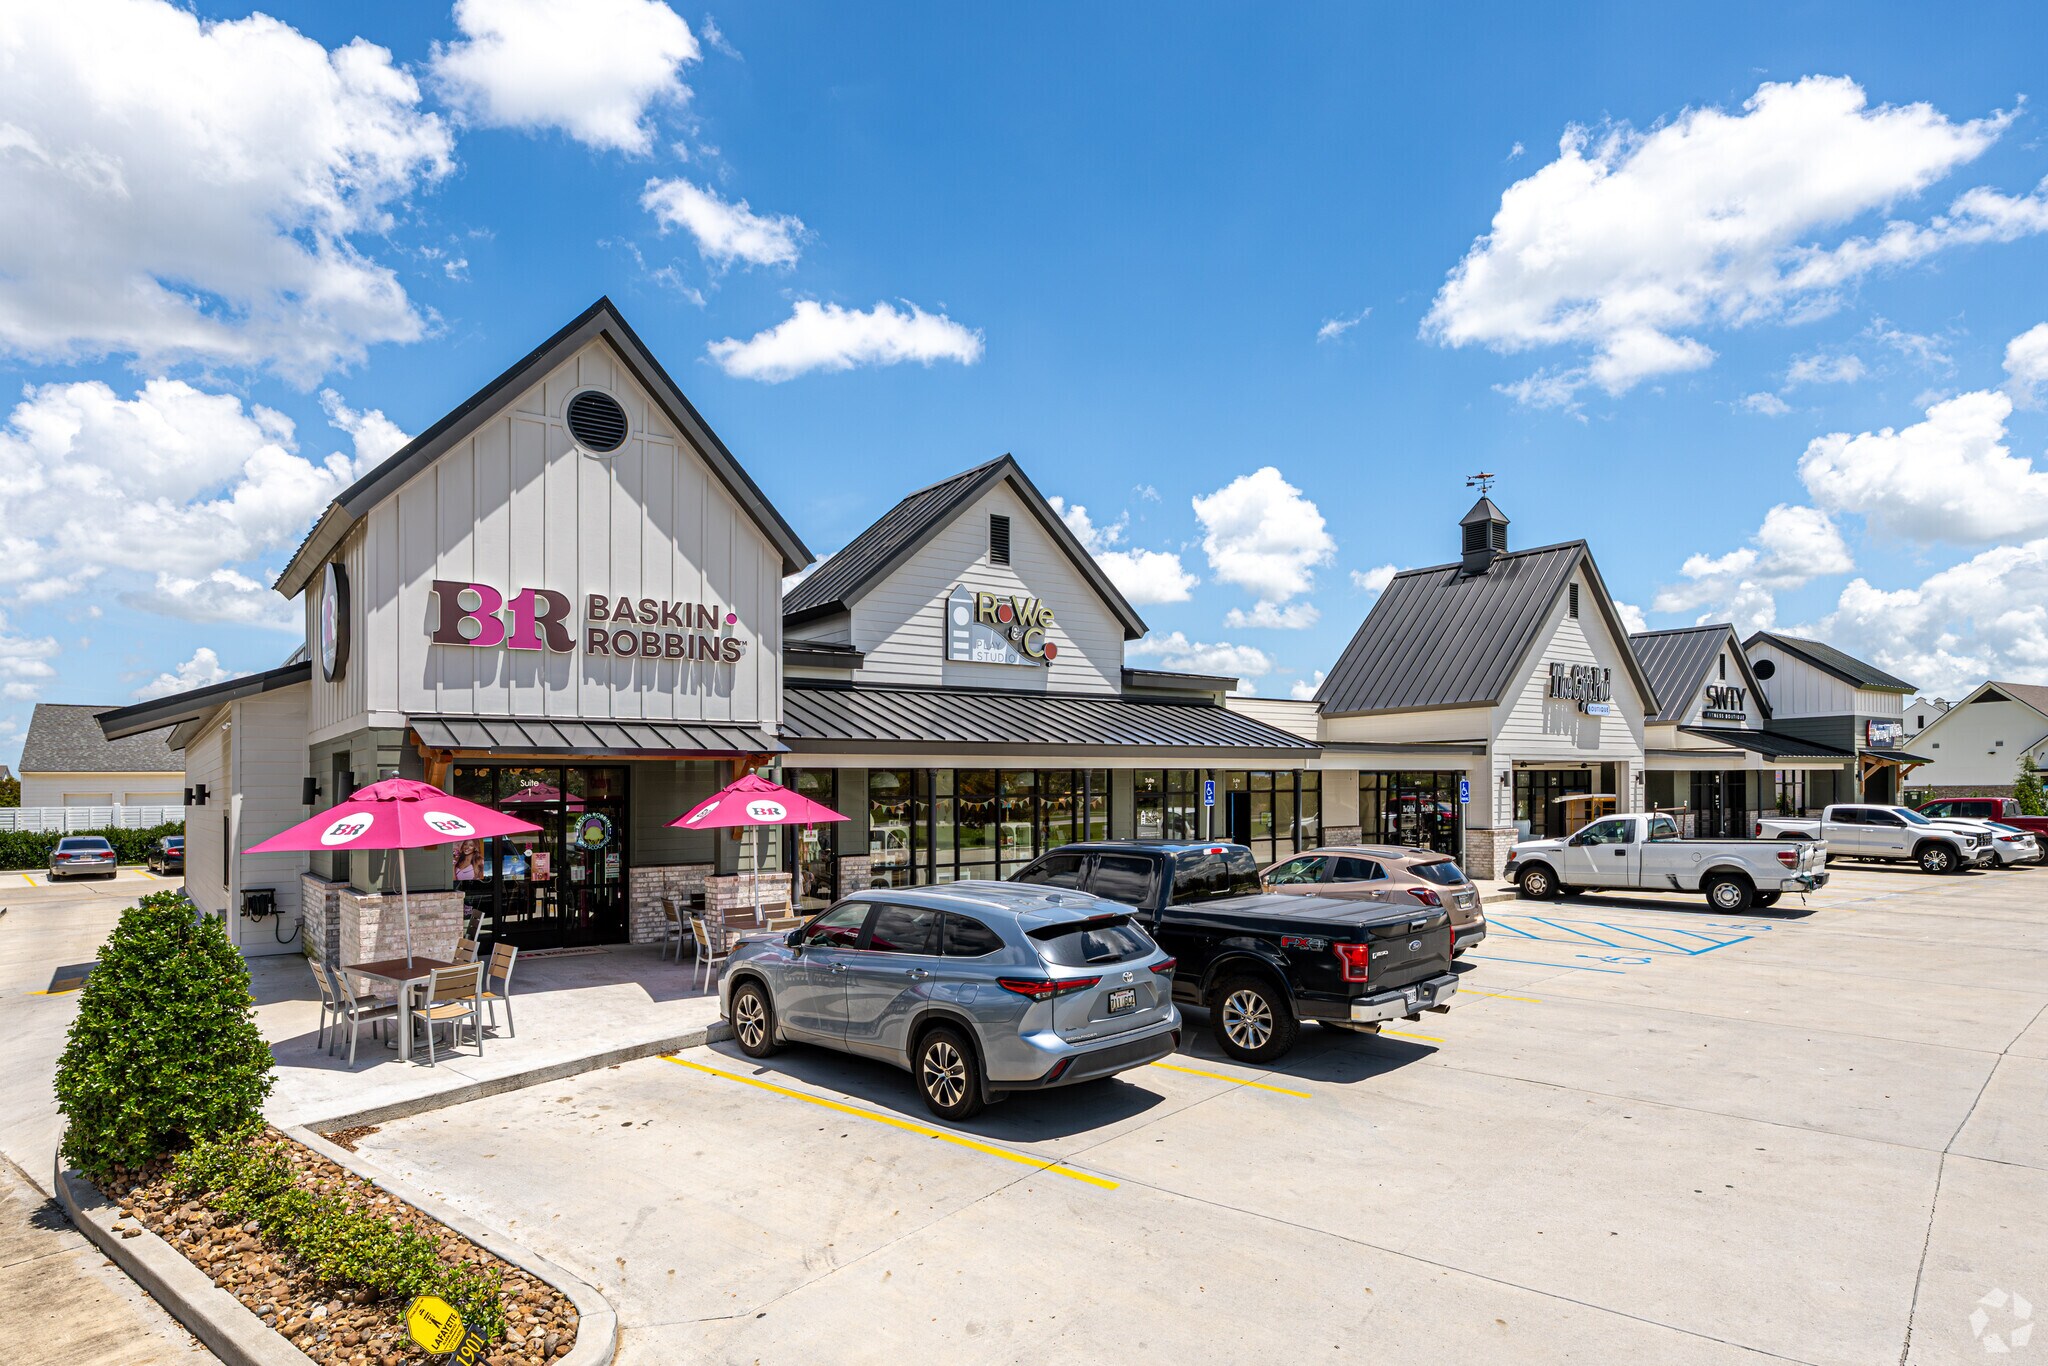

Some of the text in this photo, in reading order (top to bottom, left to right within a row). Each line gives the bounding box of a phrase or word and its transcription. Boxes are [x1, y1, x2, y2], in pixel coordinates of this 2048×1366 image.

[432, 580, 576, 653] BR
[588, 593, 719, 630] BASKIN
[588, 627, 741, 663] ROBBINS
[976, 640, 1001, 651] PLAY
[976, 652, 1016, 664] STUDIO
[1706, 685, 1747, 711] SWTY
[520, 779, 539, 787] Suite
[528, 788, 532, 796] 1
[752, 807, 781, 816] BR
[330, 823, 365, 836] BR
[432, 820, 467, 831] BR
[431, 1313, 458, 1350] LAFAYETTE
[455, 1332, 485, 1366] 1901
